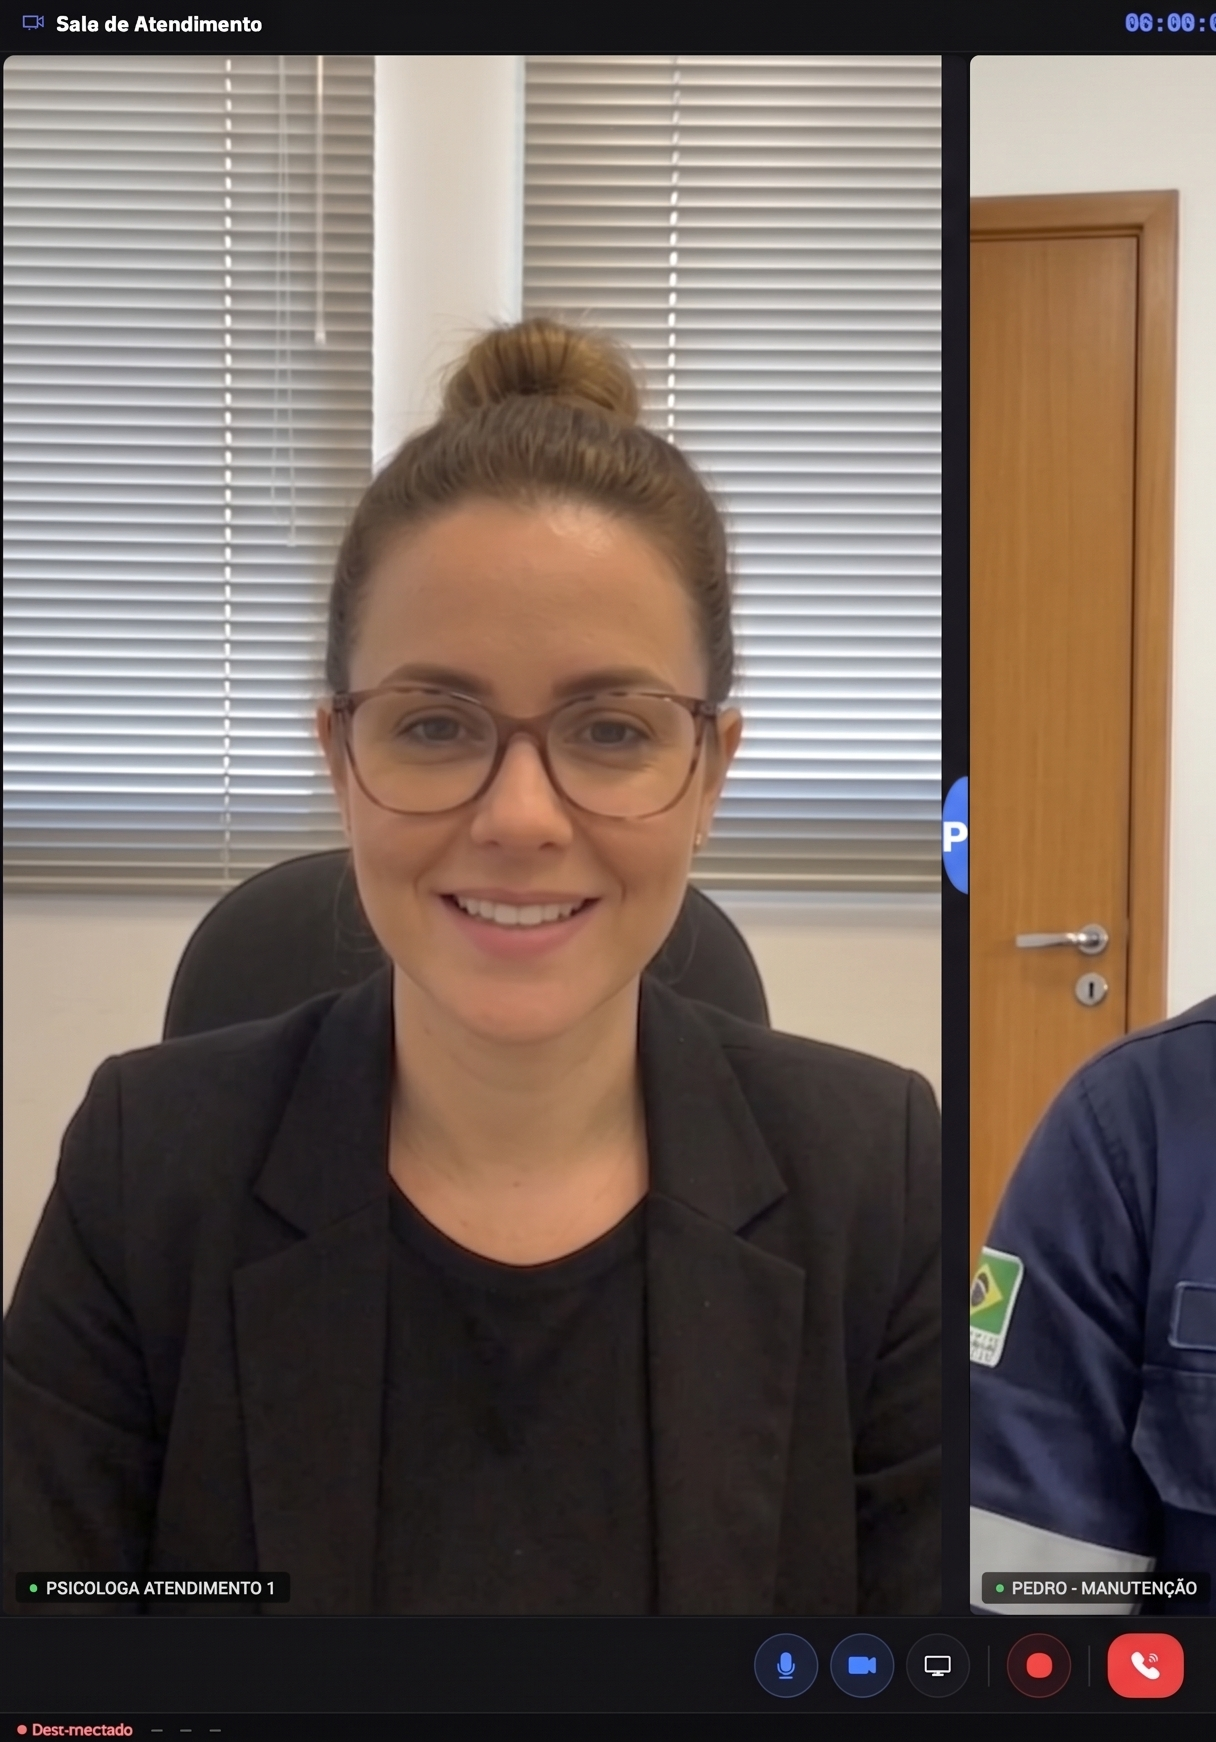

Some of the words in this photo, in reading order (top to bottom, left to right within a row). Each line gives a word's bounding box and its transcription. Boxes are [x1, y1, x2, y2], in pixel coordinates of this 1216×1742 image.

[104, 15, 130, 33] de
[134, 15, 263, 33] Atendimento
[943, 821, 968, 853] P
[46, 1580, 141, 1596] PSICOLOGA
[144, 1580, 262, 1596] ATENDIMENTO
[266, 1580, 275, 1596] 1
[1012, 1580, 1068, 1596] PEDRO
[1081, 1577, 1198, 1599] MANUTENÇÃO
